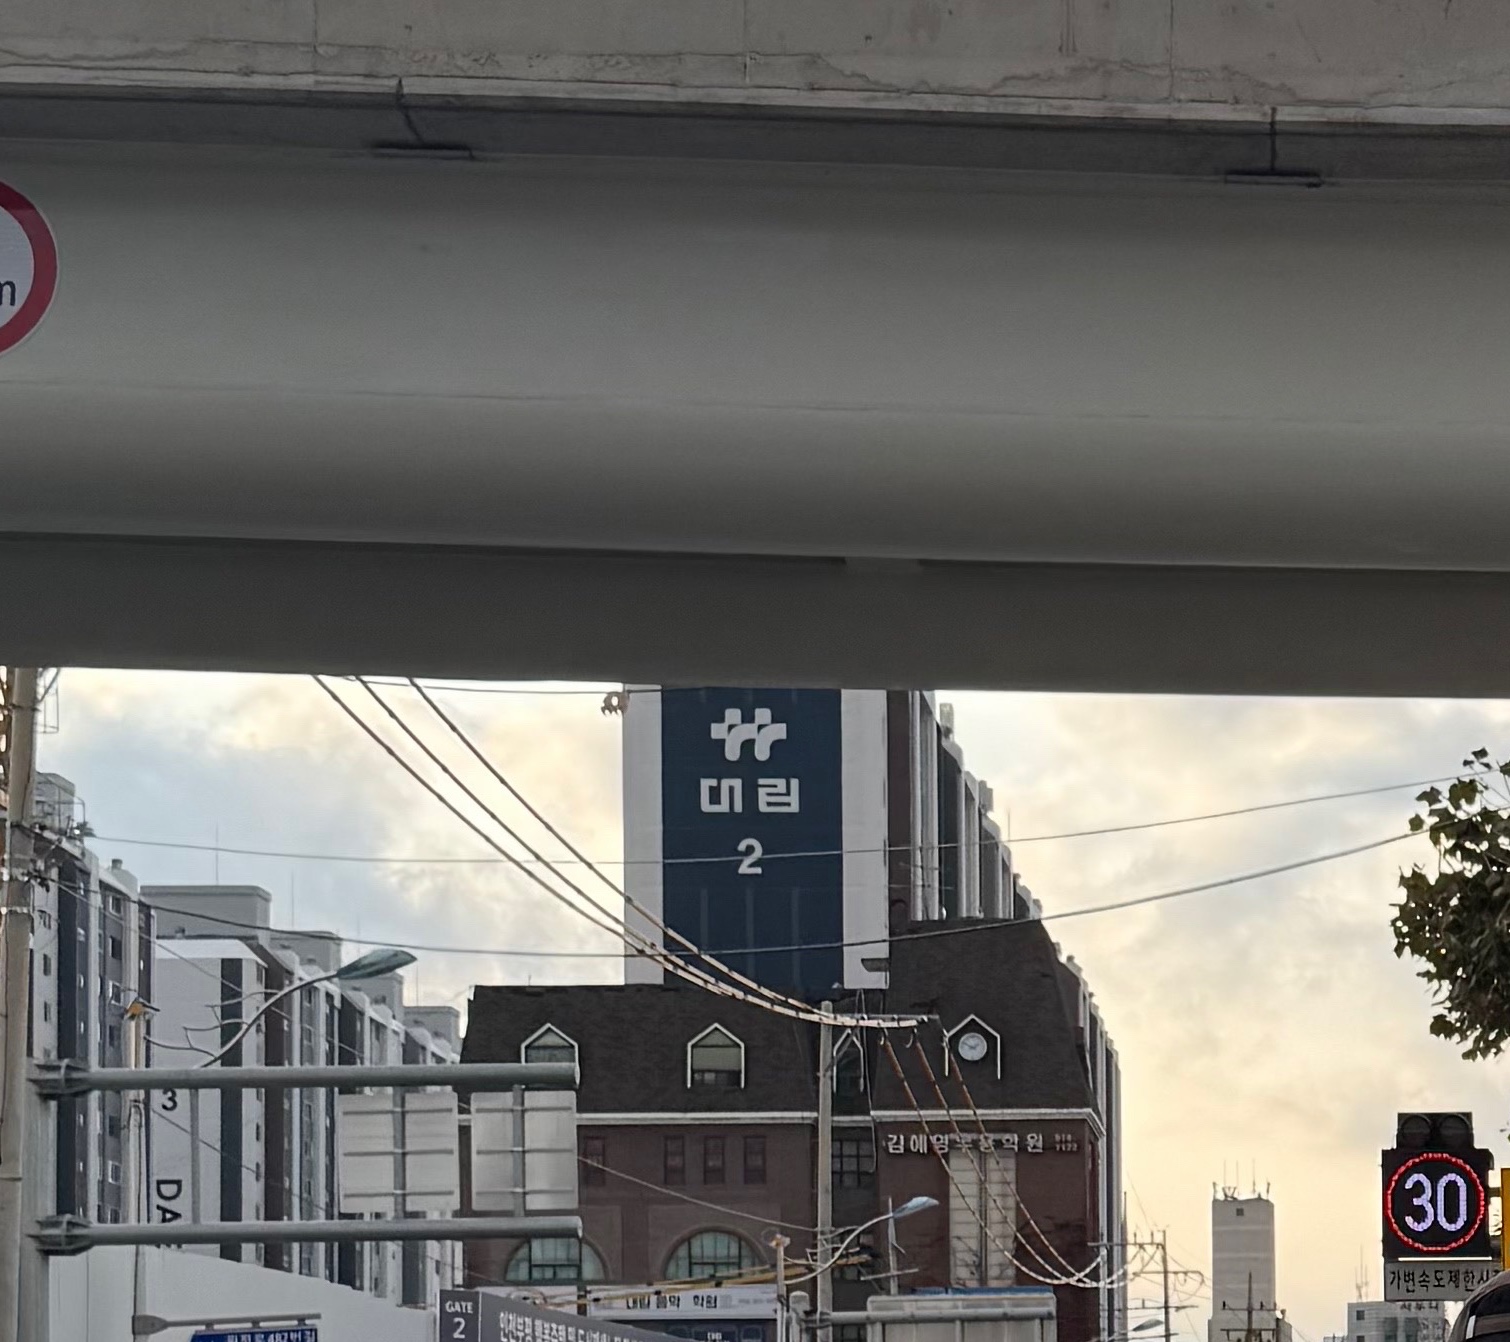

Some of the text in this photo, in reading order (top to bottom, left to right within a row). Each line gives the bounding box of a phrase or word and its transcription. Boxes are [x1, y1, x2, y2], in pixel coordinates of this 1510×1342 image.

[700, 777, 800, 813] 대림
[737, 838, 763, 874] 2
[1404, 1173, 1467, 1231] 30
[445, 1302, 474, 1314] GATE
[452, 1317, 466, 1339] 2
